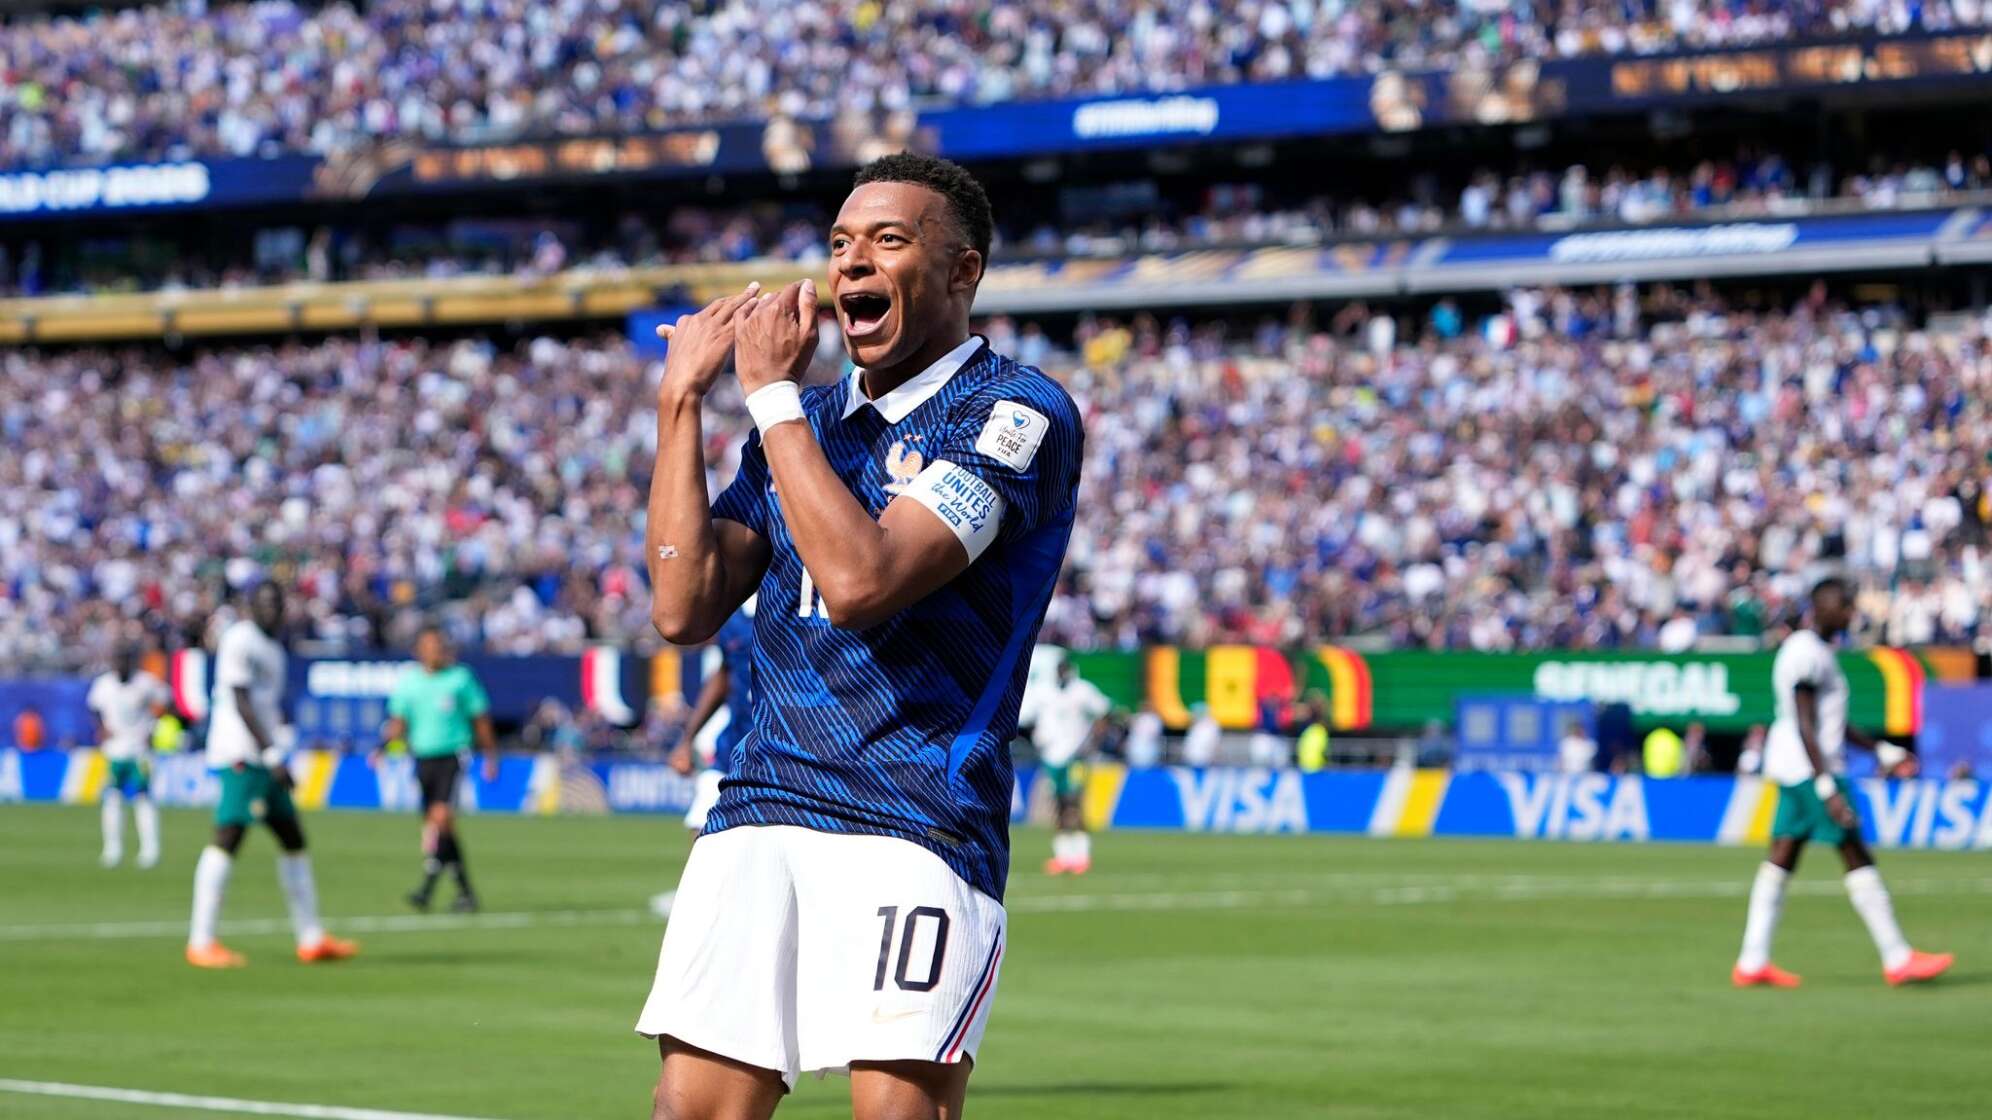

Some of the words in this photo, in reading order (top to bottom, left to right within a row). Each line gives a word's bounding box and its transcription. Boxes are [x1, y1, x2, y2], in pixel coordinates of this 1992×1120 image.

[996, 433, 1022, 454] PEACE
[931, 482, 952, 500] the
[950, 495, 984, 534] World
[942, 471, 990, 520] UNITES
[952, 464, 996, 508] FOOTBALL
[1533, 661, 1741, 715] SENEGAL
[1170, 767, 1310, 834] VISA
[1501, 772, 1650, 840] VISA
[873, 905, 950, 992] 10
